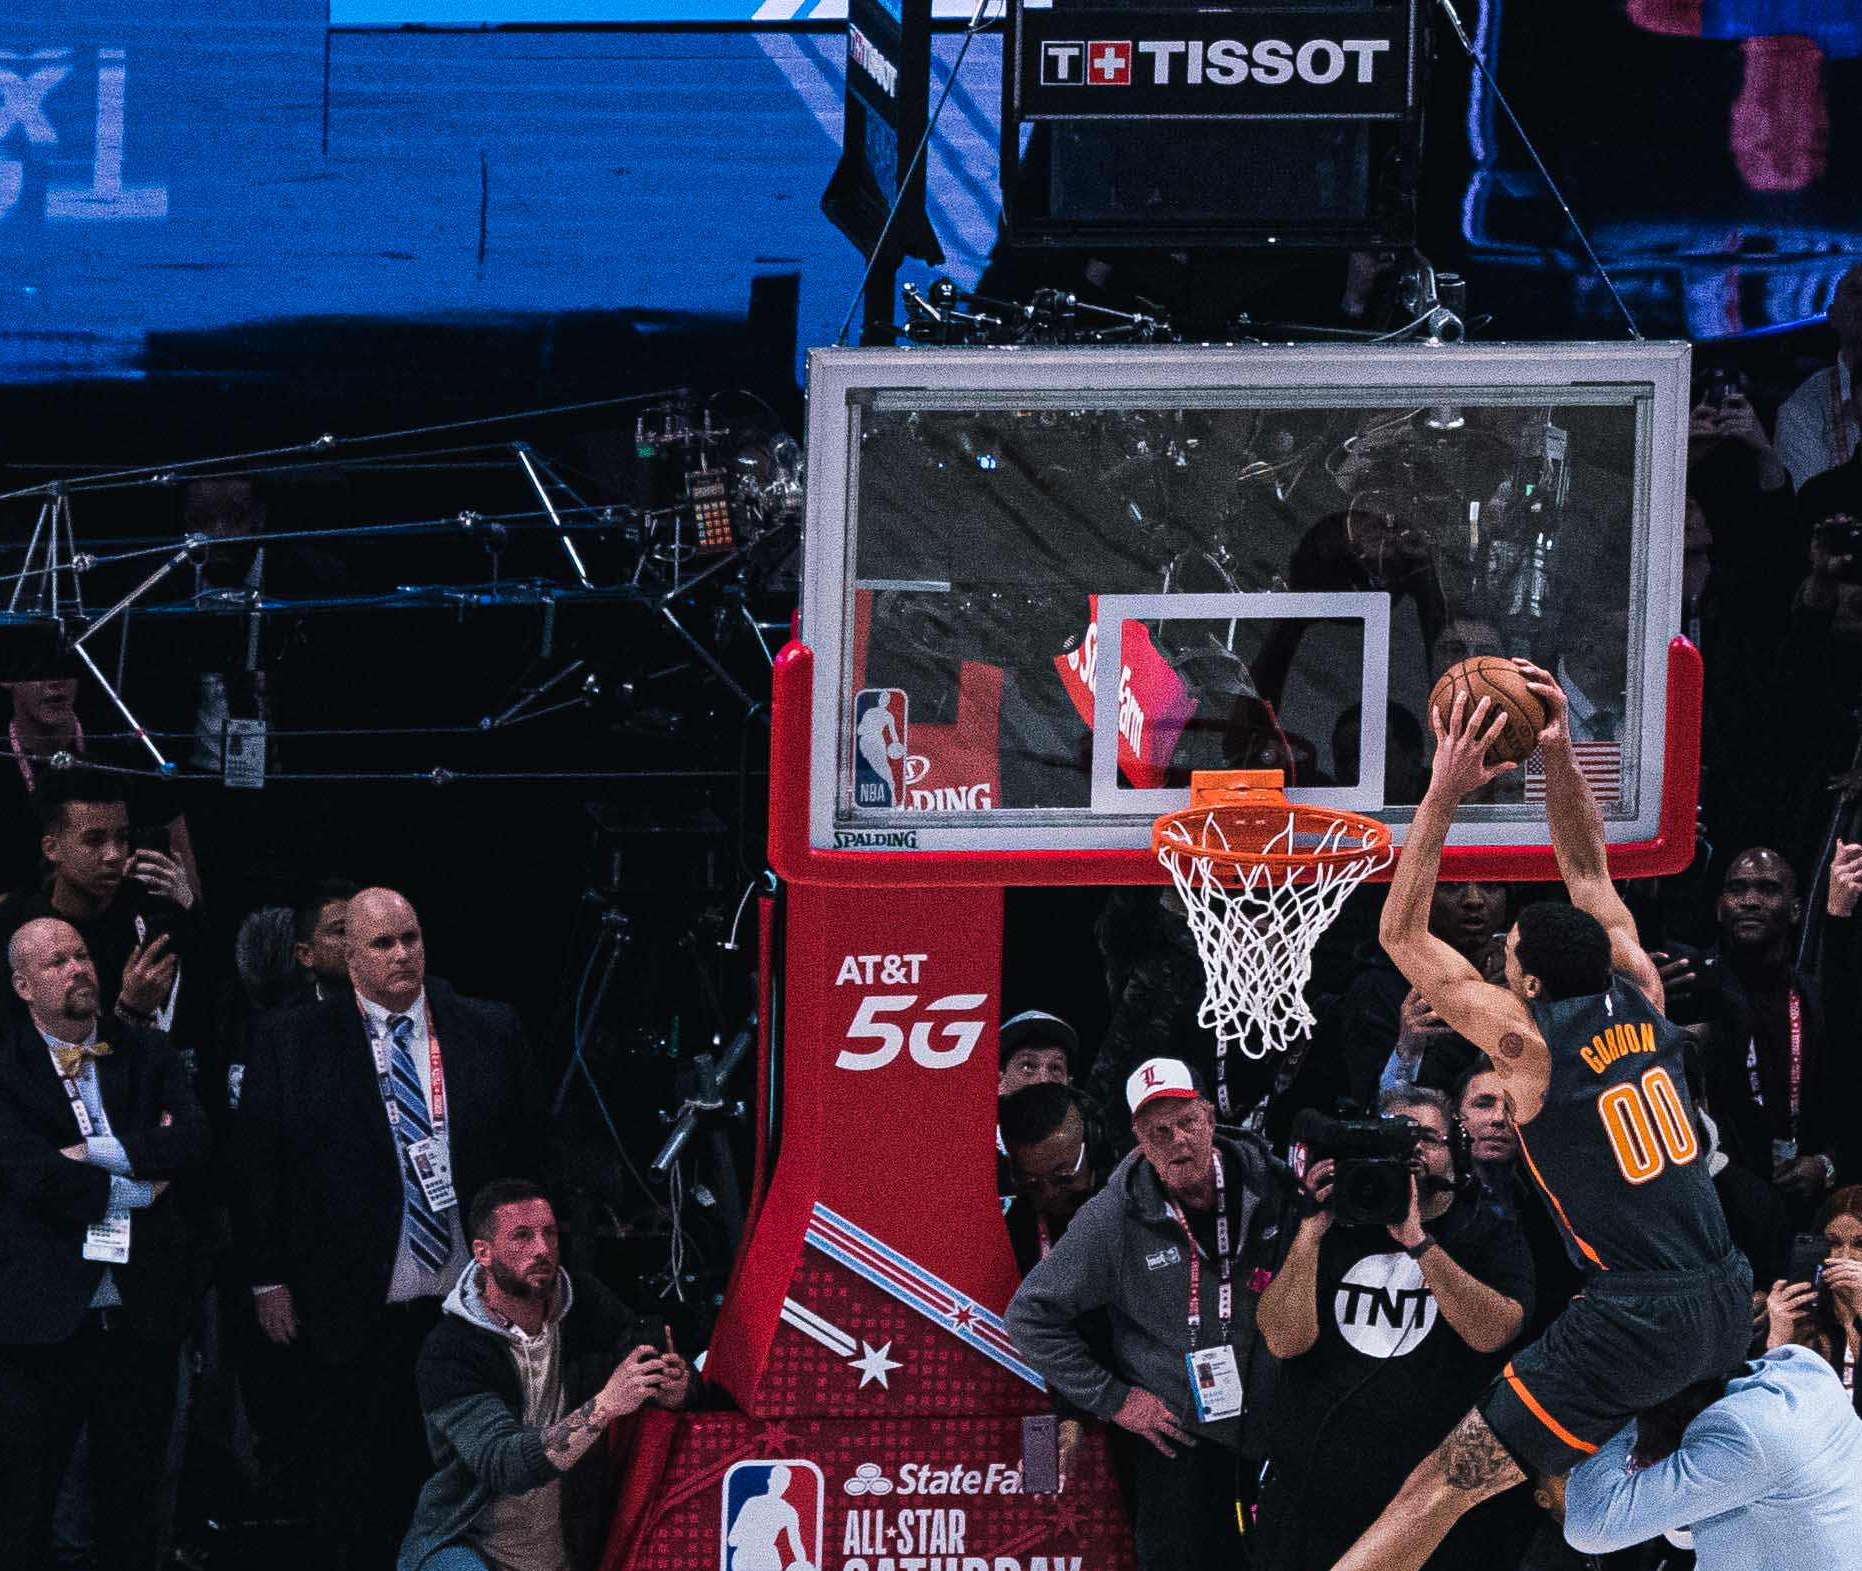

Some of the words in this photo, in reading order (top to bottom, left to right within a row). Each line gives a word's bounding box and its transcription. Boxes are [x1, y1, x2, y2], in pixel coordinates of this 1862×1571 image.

[1138, 39, 1389, 85] TISSOT
[860, 783, 885, 802] NBA
[832, 830, 918, 849] SPALDING
[834, 953, 928, 986] AT&T
[834, 993, 989, 1072] 5G
[1579, 1023, 1658, 1075] GORDON
[1140, 1064, 1166, 1088] L
[1597, 1064, 1699, 1186] 00
[1338, 1281, 1436, 1329] TNT
[896, 1463, 981, 1495] State
[983, 1463, 1064, 1496] Fa
